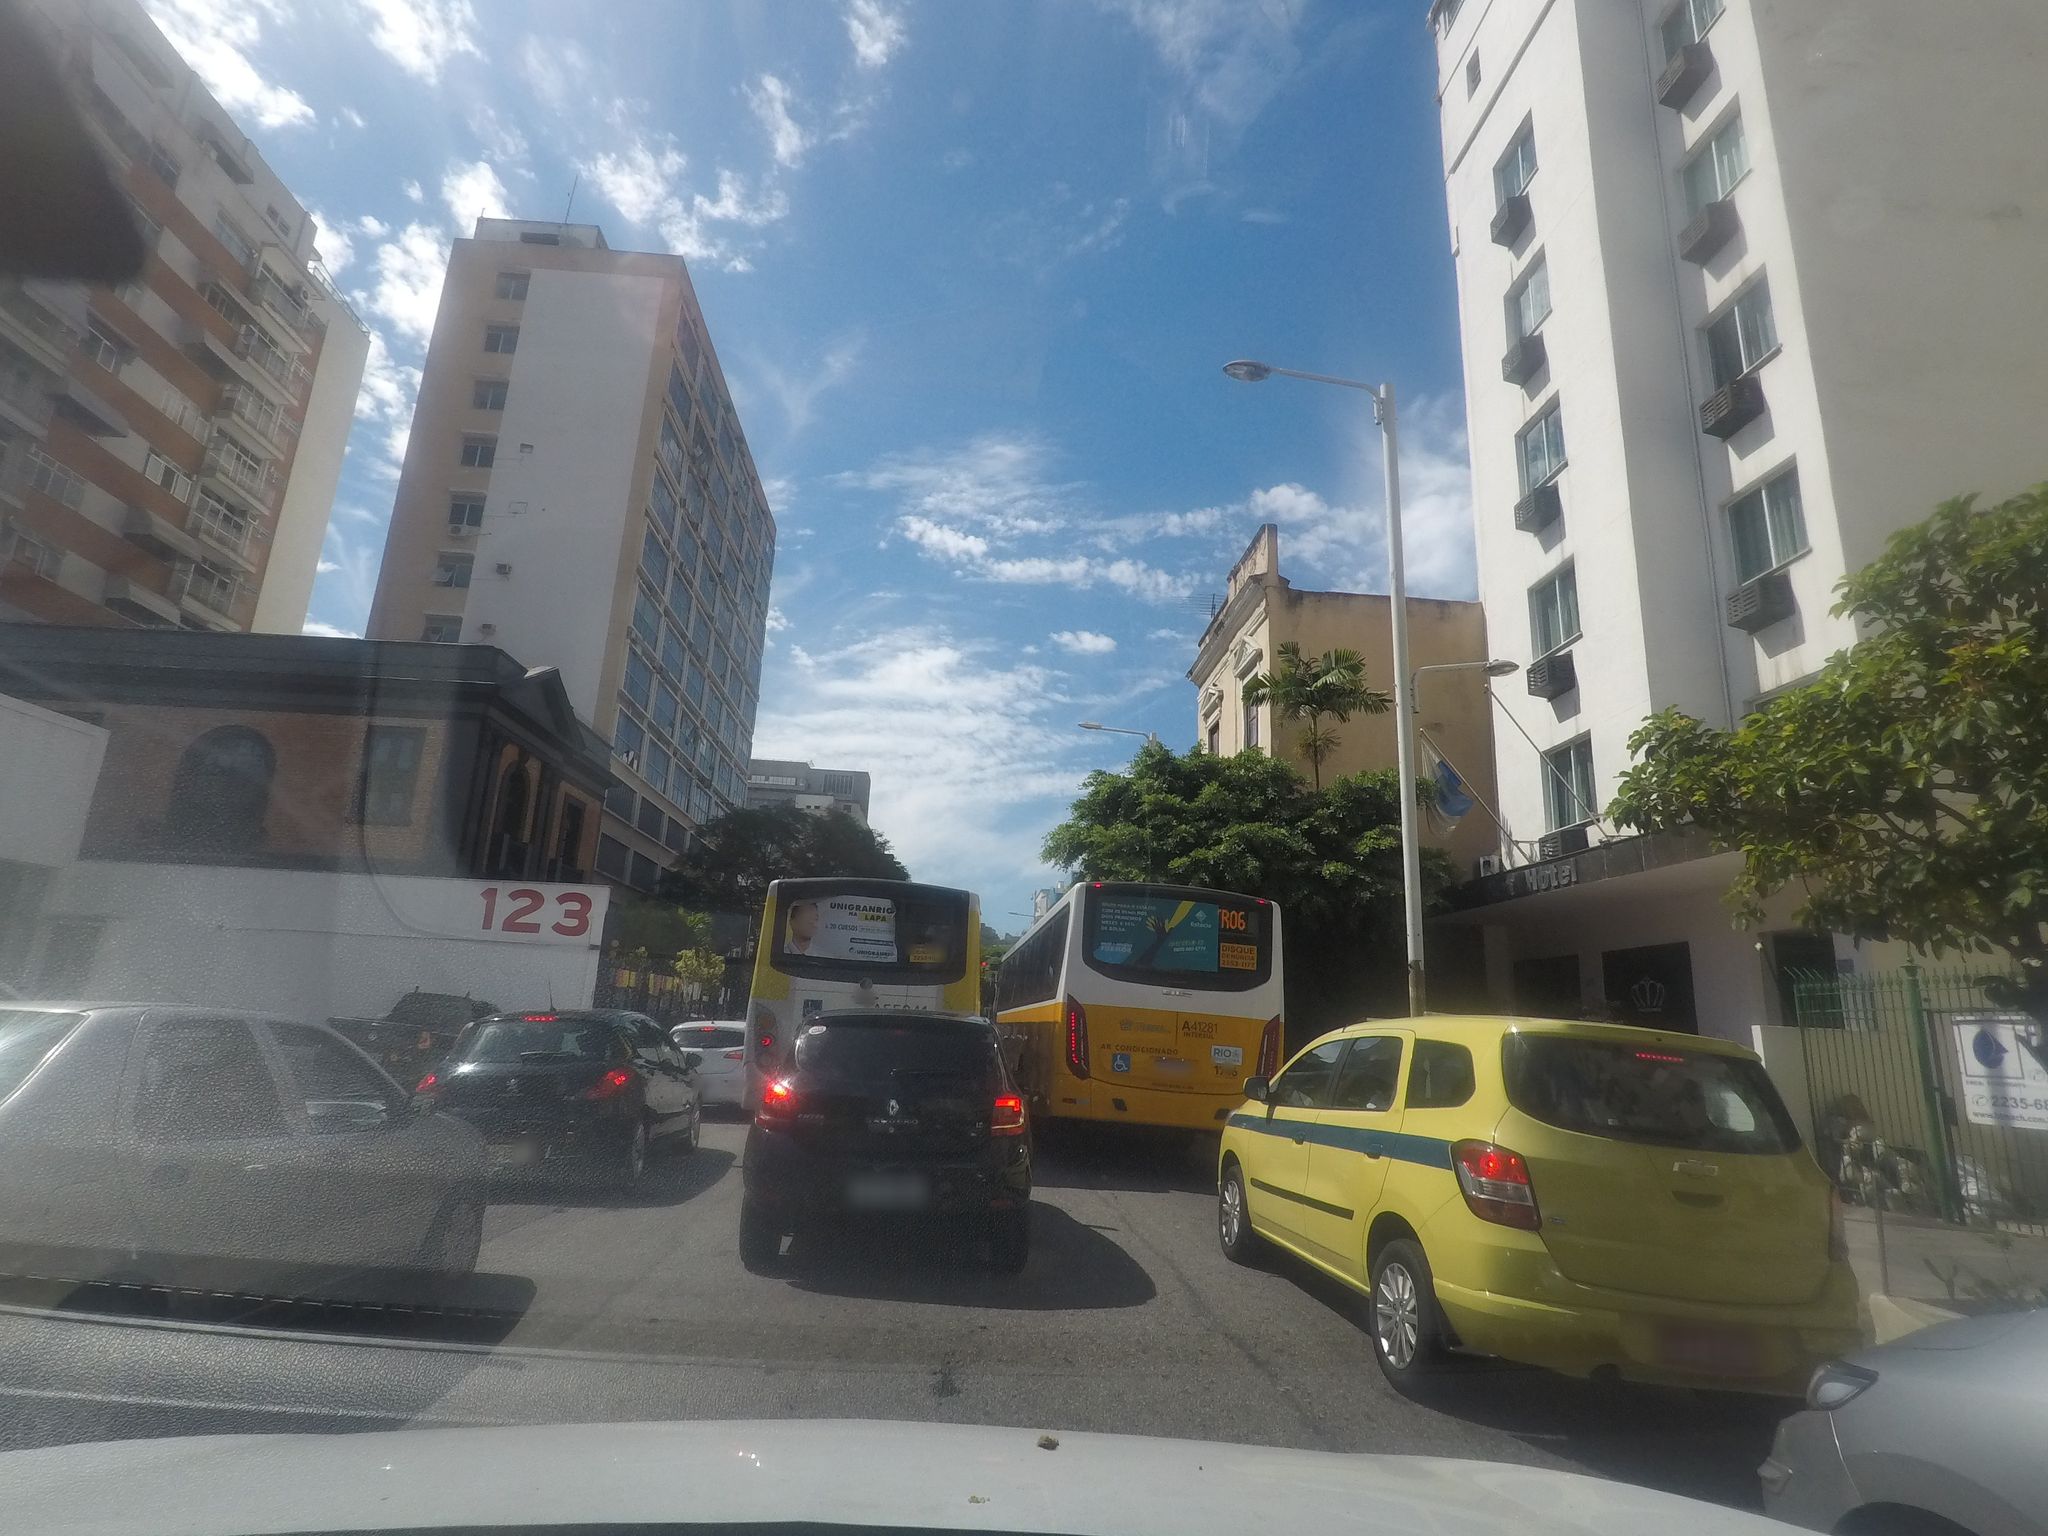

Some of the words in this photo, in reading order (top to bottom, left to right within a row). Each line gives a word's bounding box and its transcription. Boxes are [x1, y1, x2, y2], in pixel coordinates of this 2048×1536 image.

[1525, 859, 1577, 892] Hotel
[480, 887, 592, 936] 123
[864, 914, 887, 922] LAPA
[1221, 944, 1256, 955] DISQUE
[1182, 1020, 1218, 1034] A41281
[1213, 1047, 1232, 1058] RIO
